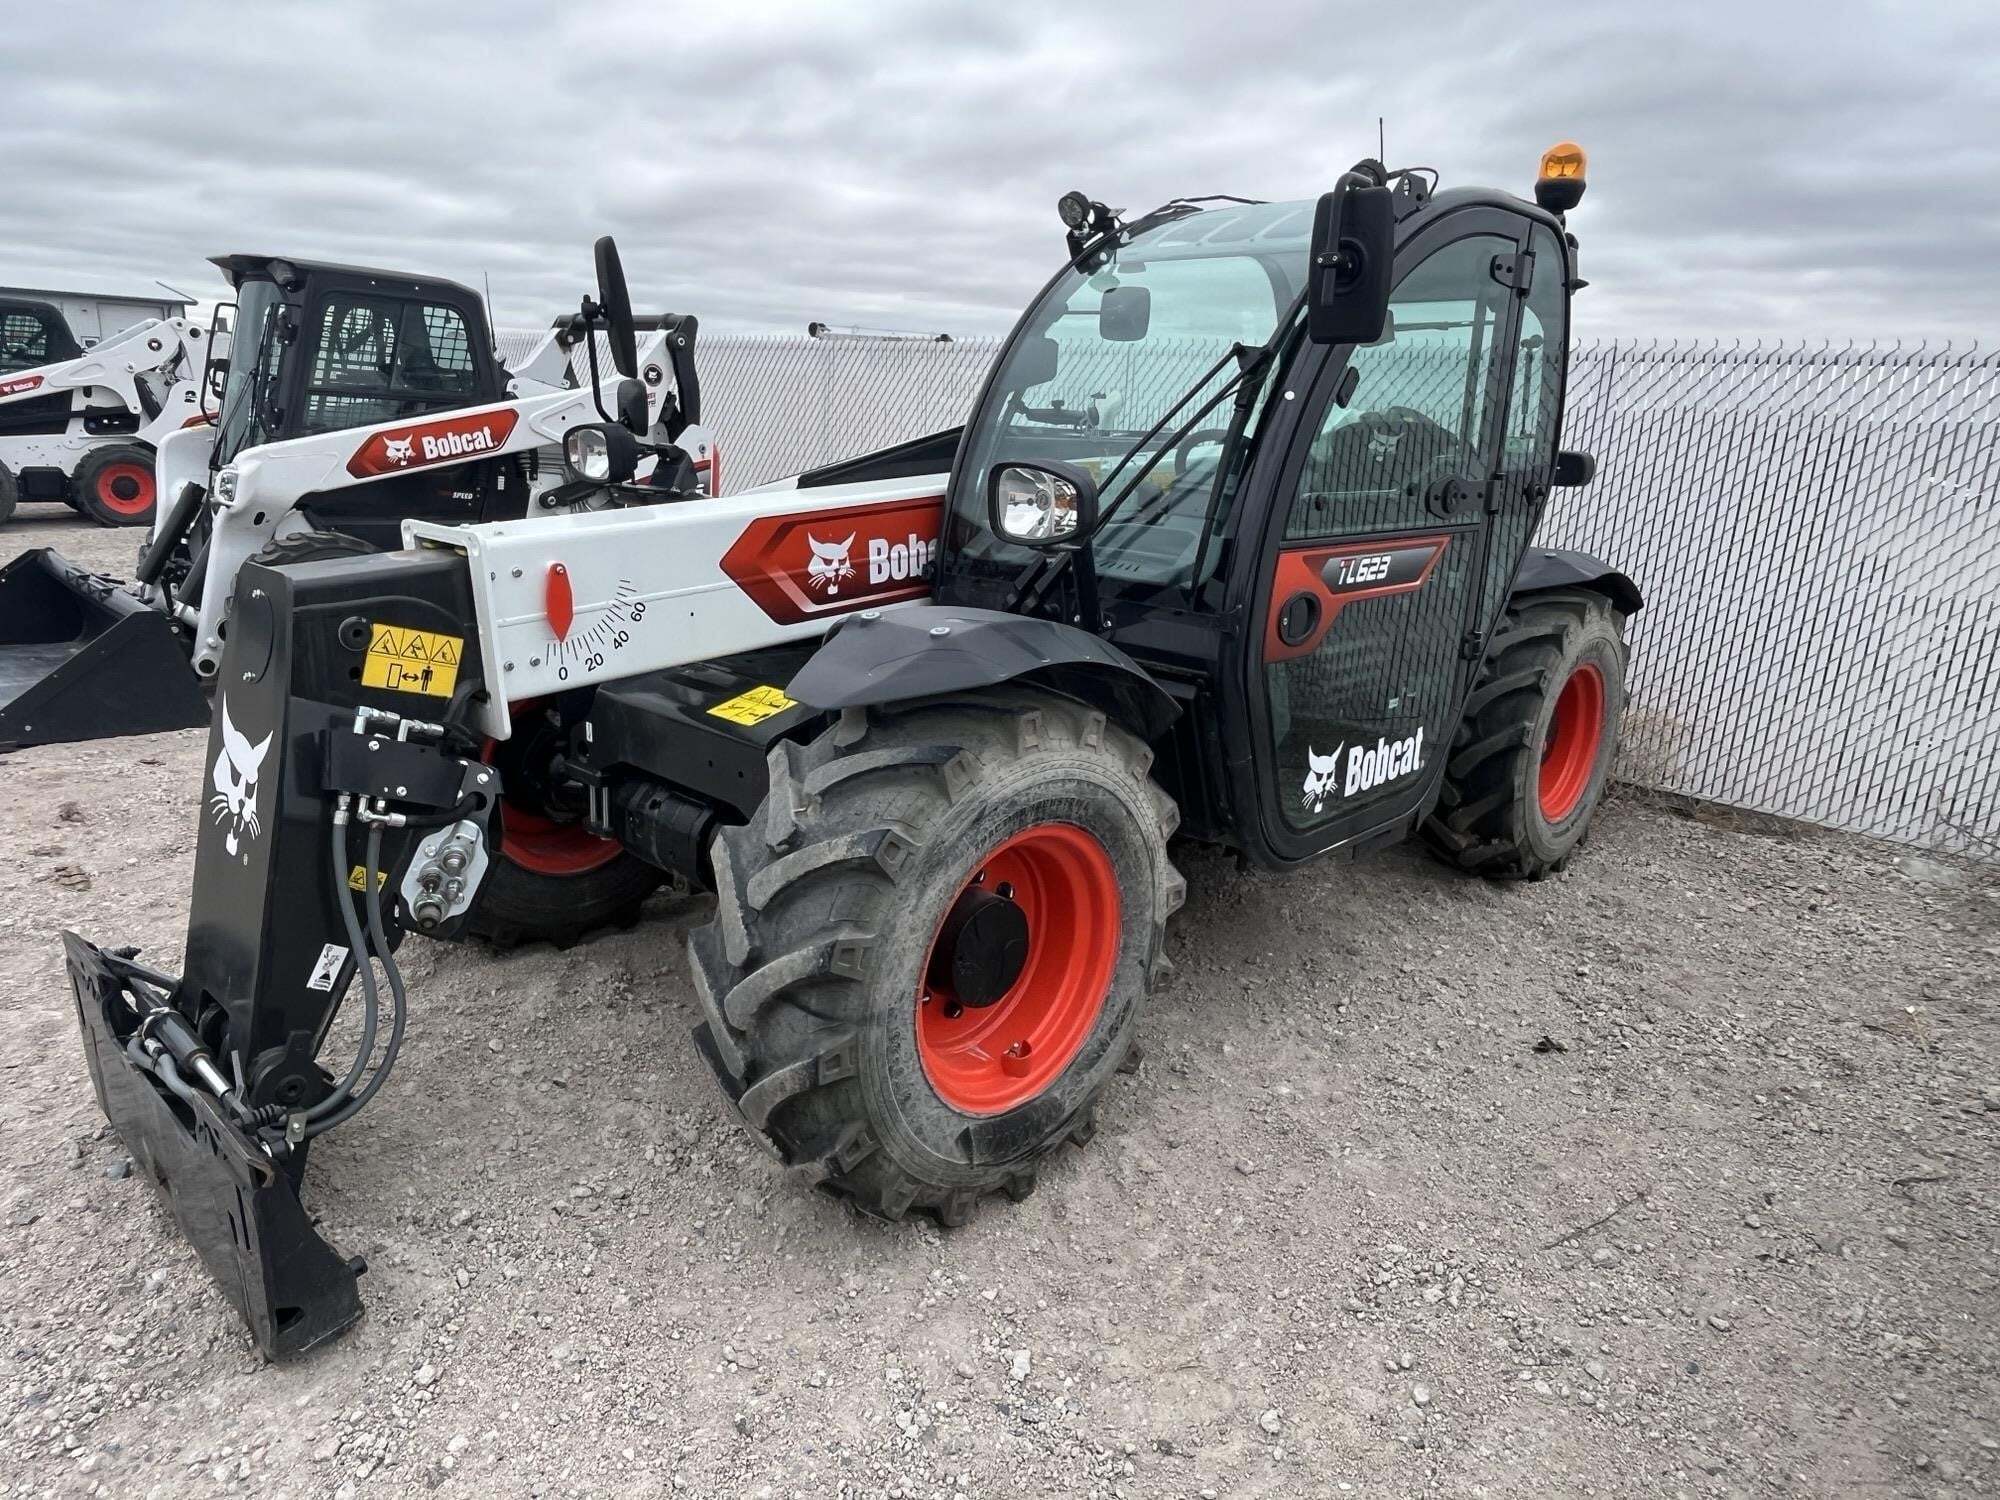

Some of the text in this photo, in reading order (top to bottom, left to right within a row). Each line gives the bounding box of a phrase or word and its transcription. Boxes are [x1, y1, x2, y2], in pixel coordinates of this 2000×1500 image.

[421, 426, 494, 460] Bobcat
[869, 533, 938, 585] Bob
[558, 602, 646, 681] 0 20 40 60
[1344, 726, 1424, 798] Bobcat
